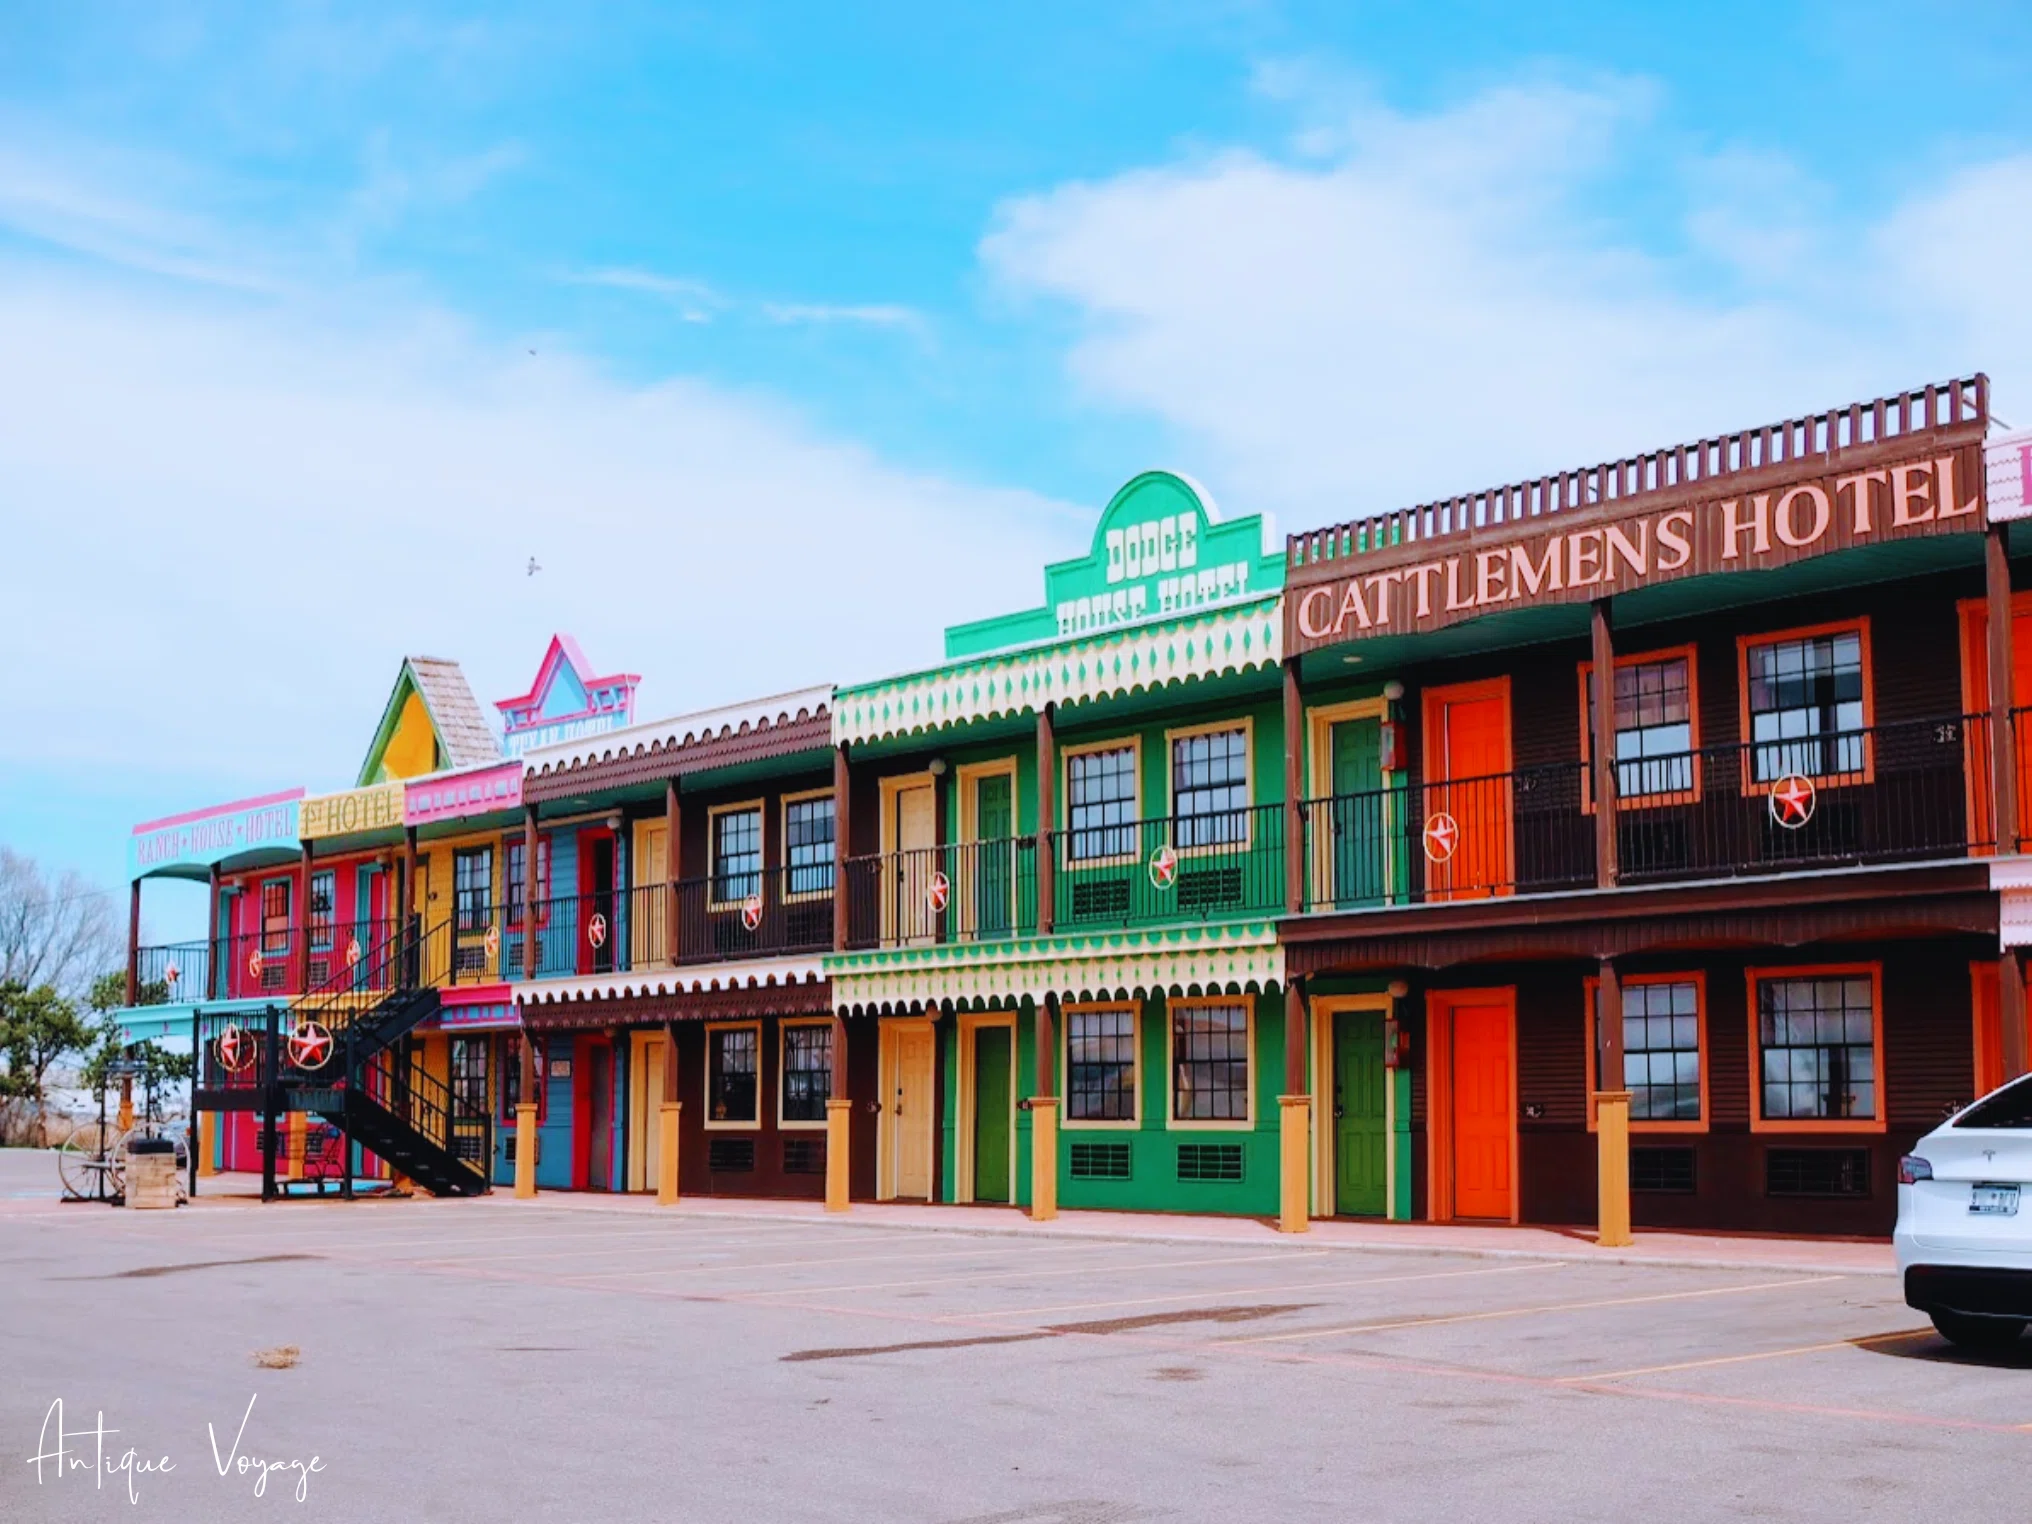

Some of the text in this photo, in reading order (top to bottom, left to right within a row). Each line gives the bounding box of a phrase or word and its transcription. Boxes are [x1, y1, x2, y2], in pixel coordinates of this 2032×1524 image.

[1106, 511, 1198, 584] DODGE
[1299, 511, 1692, 639] CATTLEMENS
[1721, 455, 1979, 559] HOTEL
[1056, 585, 1146, 637] HOUSE
[138, 808, 293, 864] RANCH HOUSE HOTEL
[327, 790, 398, 831] HOTEL
